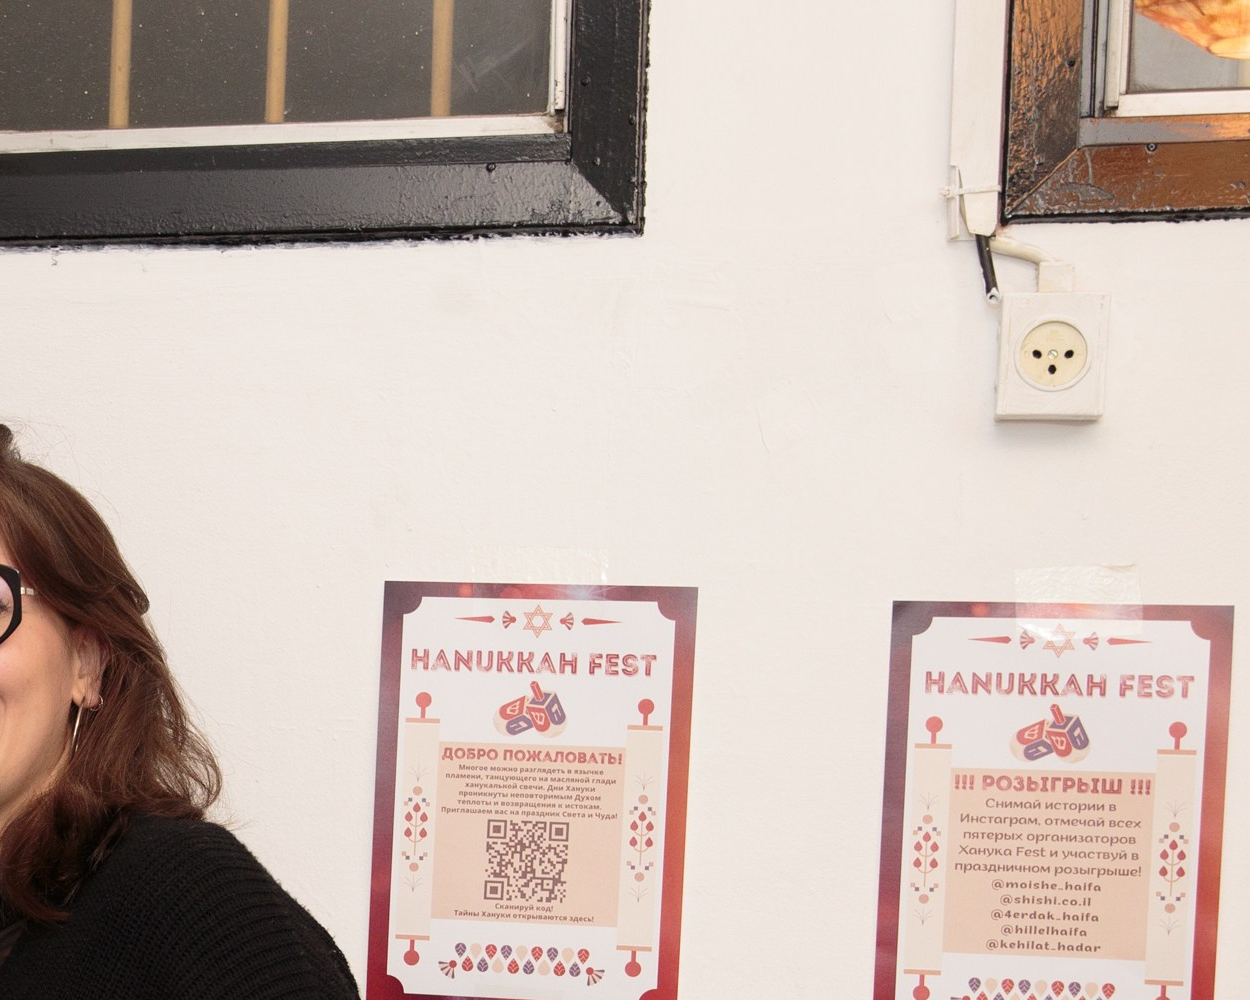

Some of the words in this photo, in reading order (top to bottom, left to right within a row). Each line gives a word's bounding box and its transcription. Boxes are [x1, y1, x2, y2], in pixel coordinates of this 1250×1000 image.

[411, 648, 577, 675] HANUKKAH
[588, 653, 657, 676] FEST
[925, 671, 1107, 697] HANUKKAH
[1119, 675, 1195, 699] FEST
[442, 747, 498, 760] ДОБРО
[503, 749, 622, 765] ПОЖАЛОВАТЬ!
[465, 781, 517, 790] ханукальной
[550, 776, 590, 784] масляной
[982, 775, 1122, 794] РОЗЫГРЫШ
[510, 792, 573, 800] неповторимым
[441, 807, 492, 815] Приглашаем
[501, 801, 556, 809] возвращения
[985, 798, 1041, 809] Снимай
[1045, 802, 1104, 812] истории
[960, 813, 1041, 827] Инстаграм,
[1044, 817, 1105, 828] отмечай
[1109, 820, 1141, 828] всех
[963, 832, 1023, 842] пятерых
[1026, 834, 1136, 846] организаторов
[959, 845, 1012, 858] Ханука
[1016, 847, 1046, 857] Fest
[1062, 851, 1127, 861] участвуй
[955, 862, 1050, 874] праздничном
[1055, 866, 1141, 878] розыгрыше!
[992, 879, 1101, 892] @moishe_haifa
[495, 903, 534, 911] Сканируй
[1000, 894, 1091, 907] @shishi.co.il
[513, 913, 567, 921] открываются
[991, 909, 1099, 922] @4erdak_haifa
[1001, 925, 1087, 937] @hillelhaifa
[986, 939, 1101, 952] @kehilat_hadar
